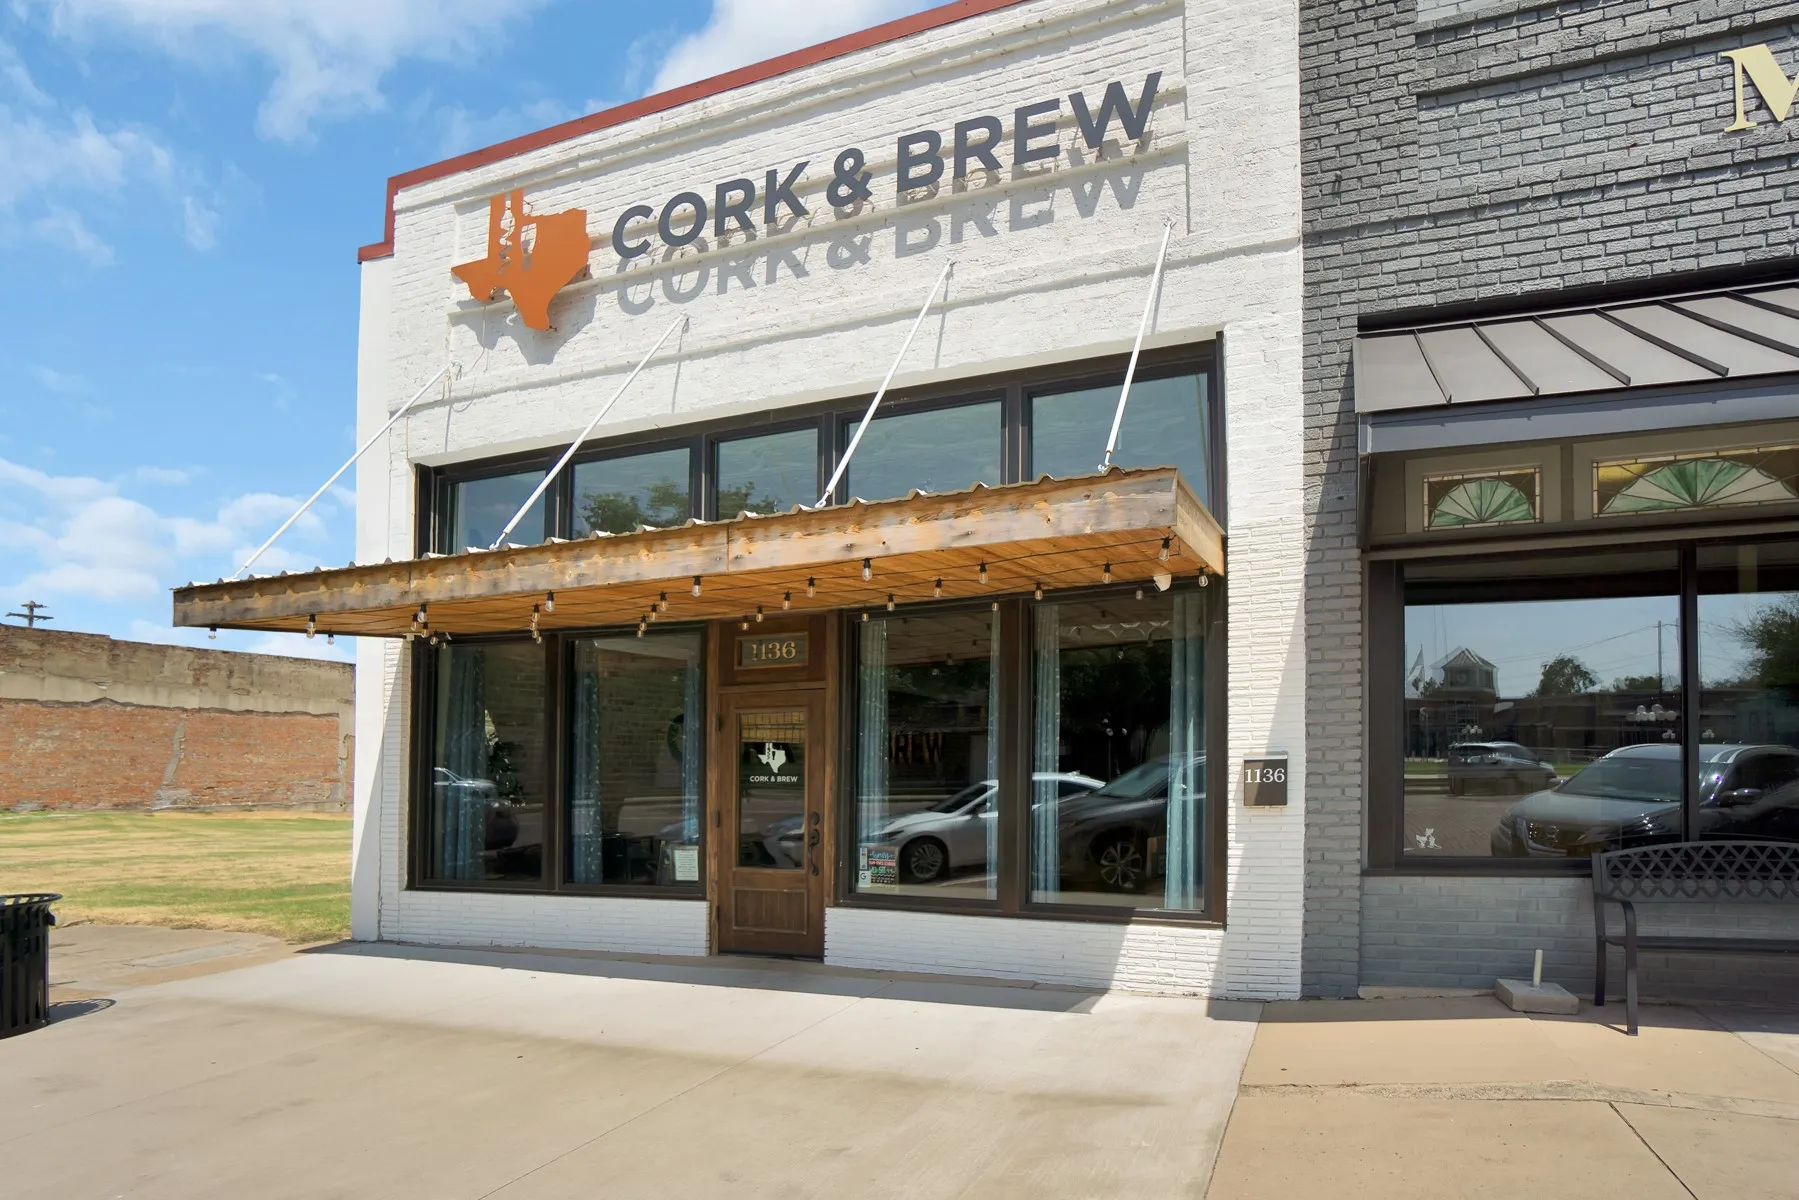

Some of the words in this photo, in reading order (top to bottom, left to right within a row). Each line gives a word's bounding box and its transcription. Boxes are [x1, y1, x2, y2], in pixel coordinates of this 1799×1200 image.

[612, 160, 810, 259] CORK
[826, 148, 873, 208] &
[897, 71, 1162, 193] BREW
[752, 641, 796, 662] 1136
[1245, 768, 1285, 783] 1136
